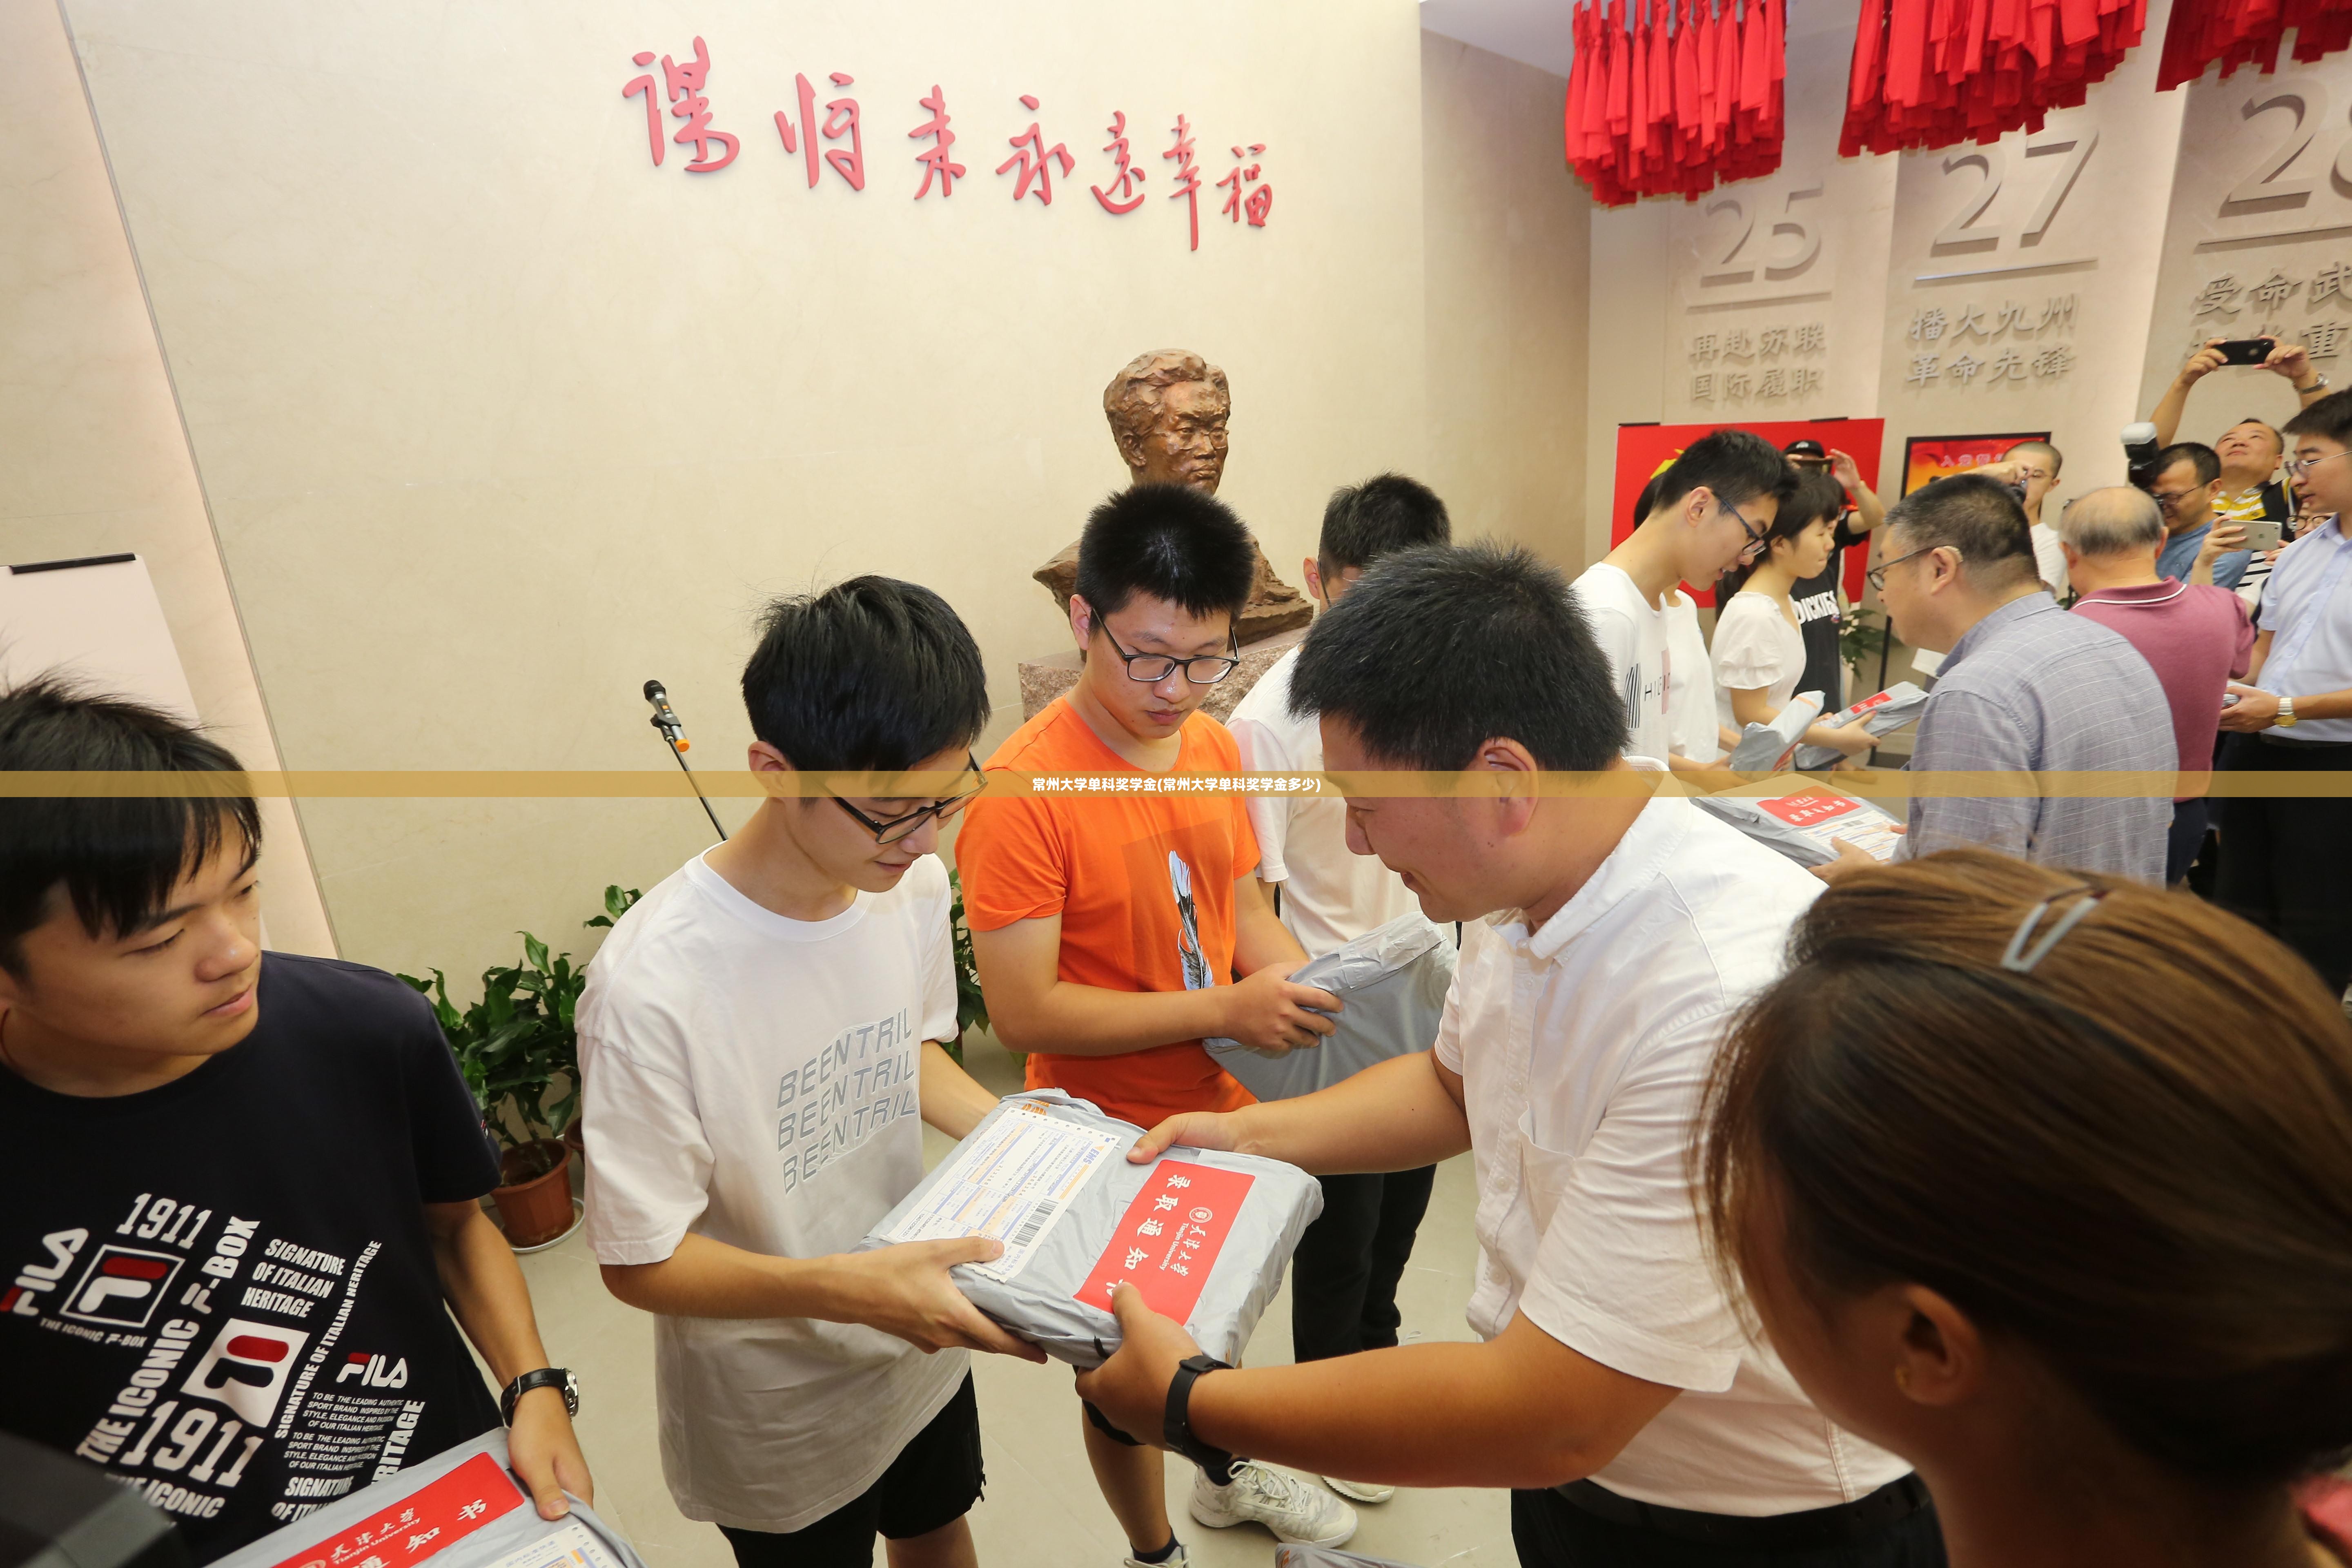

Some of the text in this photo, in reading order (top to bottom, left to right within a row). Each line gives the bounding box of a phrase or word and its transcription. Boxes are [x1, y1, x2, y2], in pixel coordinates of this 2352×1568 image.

[2223, 80, 2352, 210] 2
[1933, 129, 2099, 250] 27
[1702, 182, 1823, 284] 25
[1690, 324, 1826, 363] 再赴苏联
[1692, 368, 1824, 402] 国际履职
[1906, 345, 2076, 387] 革命先锋
[777, 1007, 912, 1109] BEENTRIL
[777, 1050, 914, 1153] BEENTRIL
[783, 1090, 916, 1195] BEENTRIL
[1083, 1148, 1100, 1165] EMS
[116, 1193, 212, 1250] 1911
[264, 1238, 346, 1276] SIGNATURE
[1158, 1223, 1189, 1271] Tianjin University
[1170, 1224, 1207, 1277] 天津大学
[0, 1227, 89, 1316] FILA
[252, 1262, 335, 1299] OF ITALIAN
[241, 1287, 315, 1318] HERITAGE
[40, 1318, 147, 1348] THE ICONIC F-BOX
[75, 1418, 136, 1464] THE
[108, 1319, 200, 1417] ICONIC
[180, 1216, 261, 1314] F-BOX
[274, 1240, 382, 1439] SIGNATURE OF ITALIAN HERITAGE
[336, 1352, 408, 1389] FILA
[303, 1410, 328, 1420] STYLE,
[329, 1414, 365, 1423] ELEGANCE
[307, 1401, 333, 1410] SPORT
[333, 1405, 359, 1413] BRAND
[351, 1398, 378, 1406] LEADING
[119, 1400, 264, 1488] 1911
[317, 1434, 332, 1443] THE
[332, 1436, 361, 1444] LEADING
[320, 1421, 336, 1429] OUR
[336, 1423, 362, 1431] ITALIAN
[370, 1400, 425, 1484] RITAGE
[283, 1450, 307, 1459] STYLE,
[308, 1453, 347, 1462] ELEGANCE
[288, 1441, 313, 1450] SPORT
[312, 1443, 340, 1452] BRAND
[299, 1461, 316, 1470] OUR
[141, 1479, 226, 1519] ICONIC
[284, 1474, 355, 1497] SIGNATURE
[271, 1501, 296, 1521] OF
[331, 1508, 414, 1560] 天津大学
[333, 1517, 421, 1565] Tianjin University
